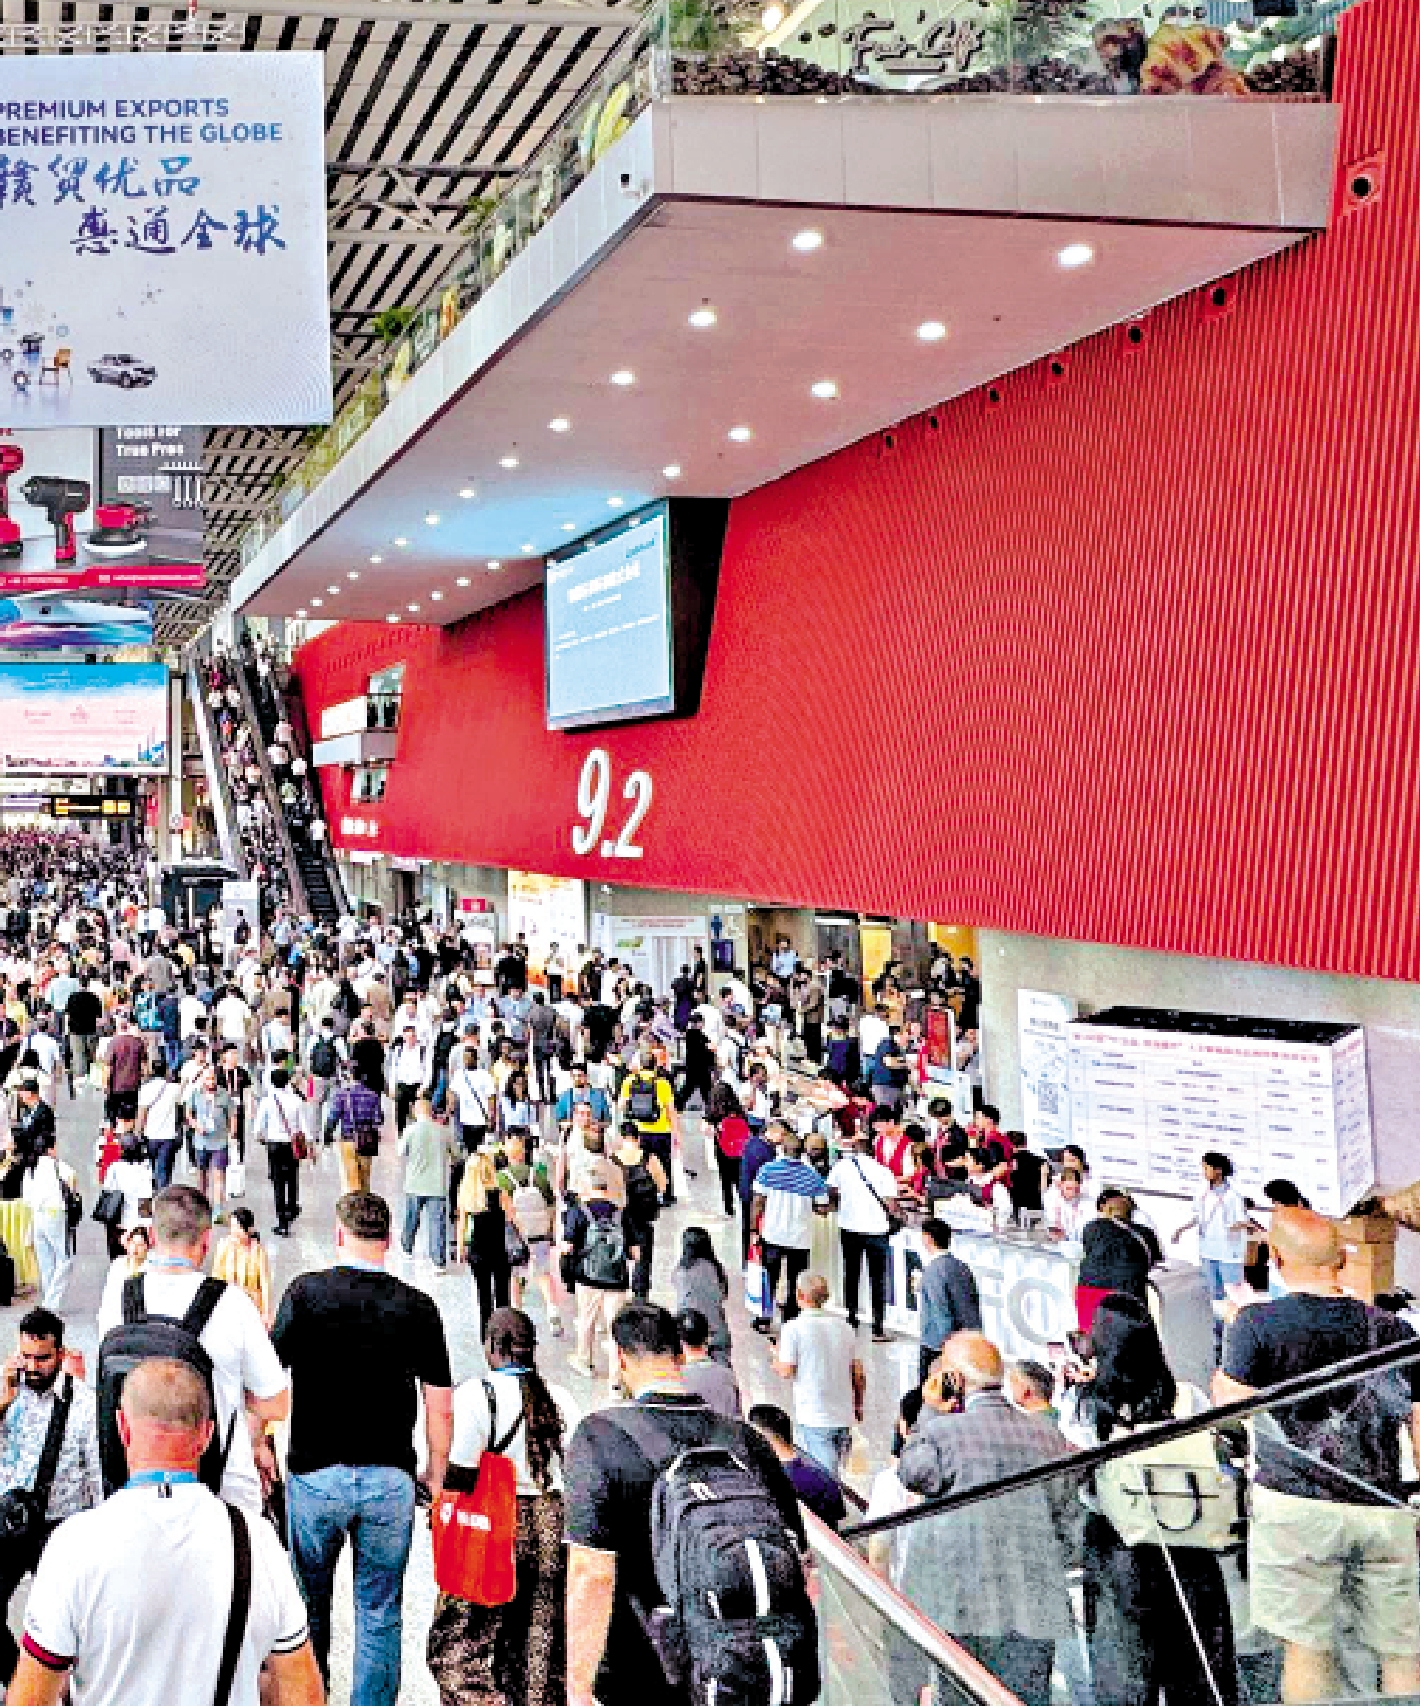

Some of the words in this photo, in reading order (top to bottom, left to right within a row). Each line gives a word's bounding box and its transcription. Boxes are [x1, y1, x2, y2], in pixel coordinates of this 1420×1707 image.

[115, 97, 229, 119] EXPORTS
[143, 124, 192, 145] THE
[198, 122, 283, 144] GLOBE
[70, 203, 287, 256] 惠通全球
[116, 444, 149, 457] True
[152, 442, 184, 456] Pros
[571, 748, 655, 858] 9.2
